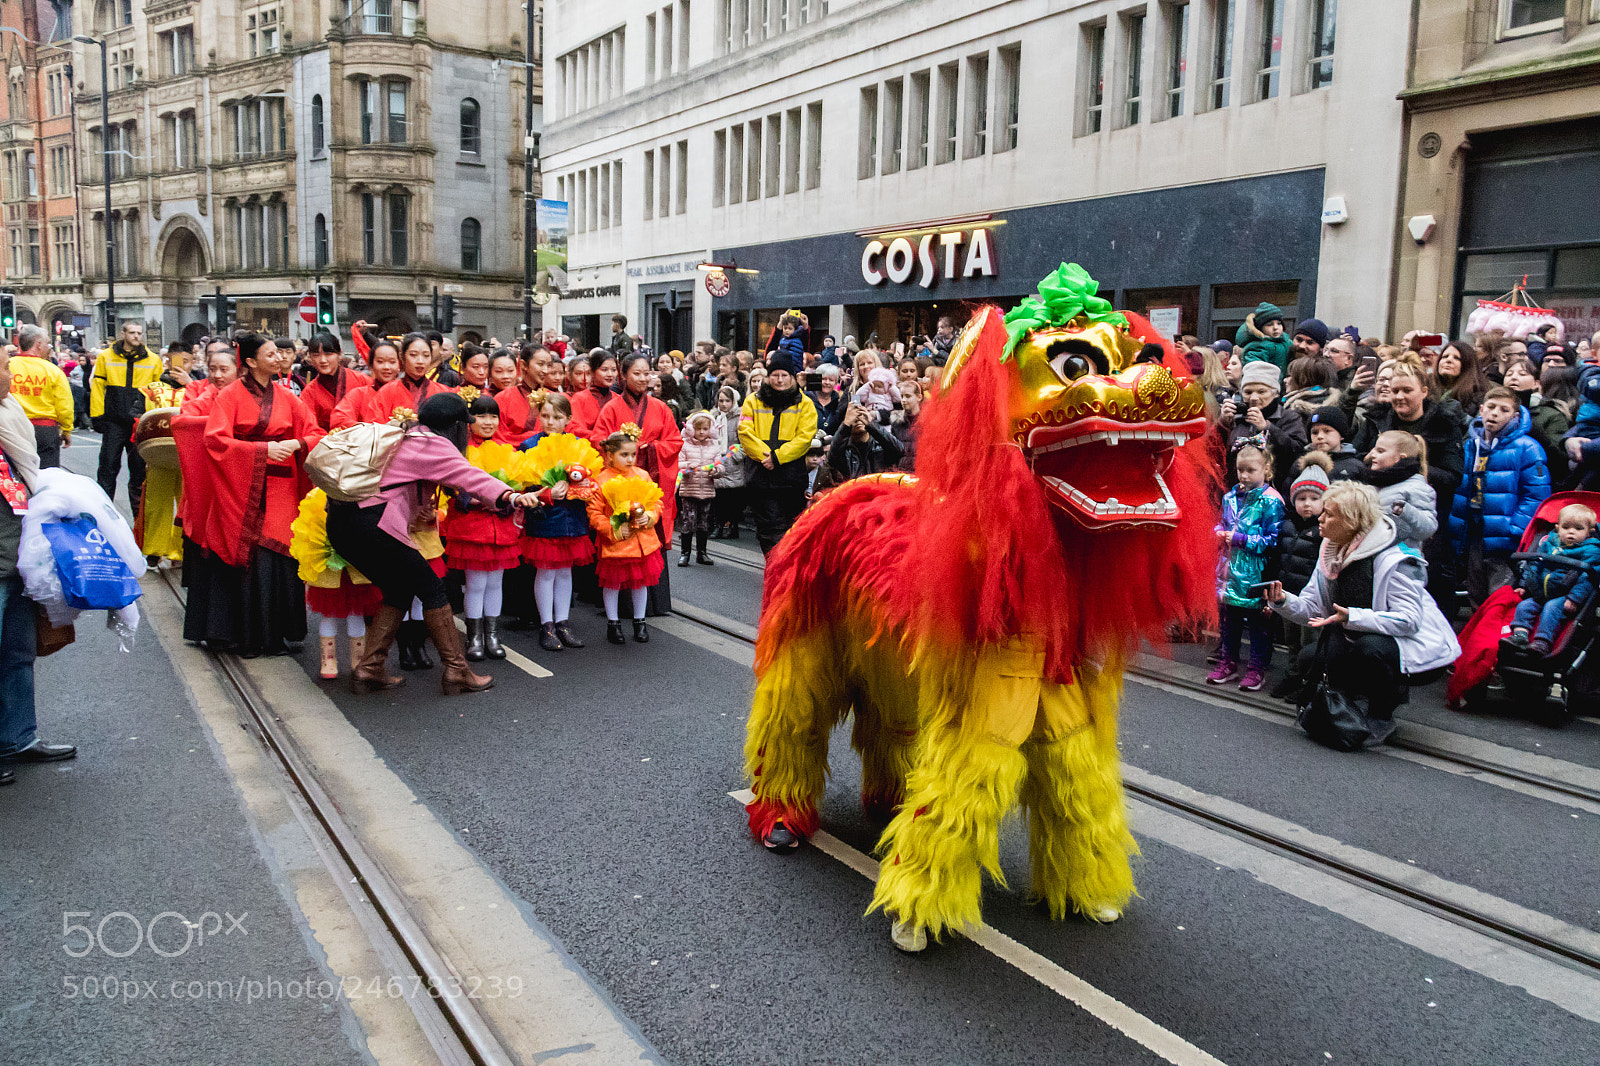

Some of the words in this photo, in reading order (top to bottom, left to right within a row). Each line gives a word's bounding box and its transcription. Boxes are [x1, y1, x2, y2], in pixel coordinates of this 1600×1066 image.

[861, 228, 994, 289] COSTA
[626, 267, 643, 278] PEARL
[646, 262, 681, 276] ASSURANCE
[684, 258, 703, 273] HOU
[560, 287, 595, 299] ARBUCKS
[596, 284, 621, 298] COFFEE
[10, 373, 47, 386] CAM
